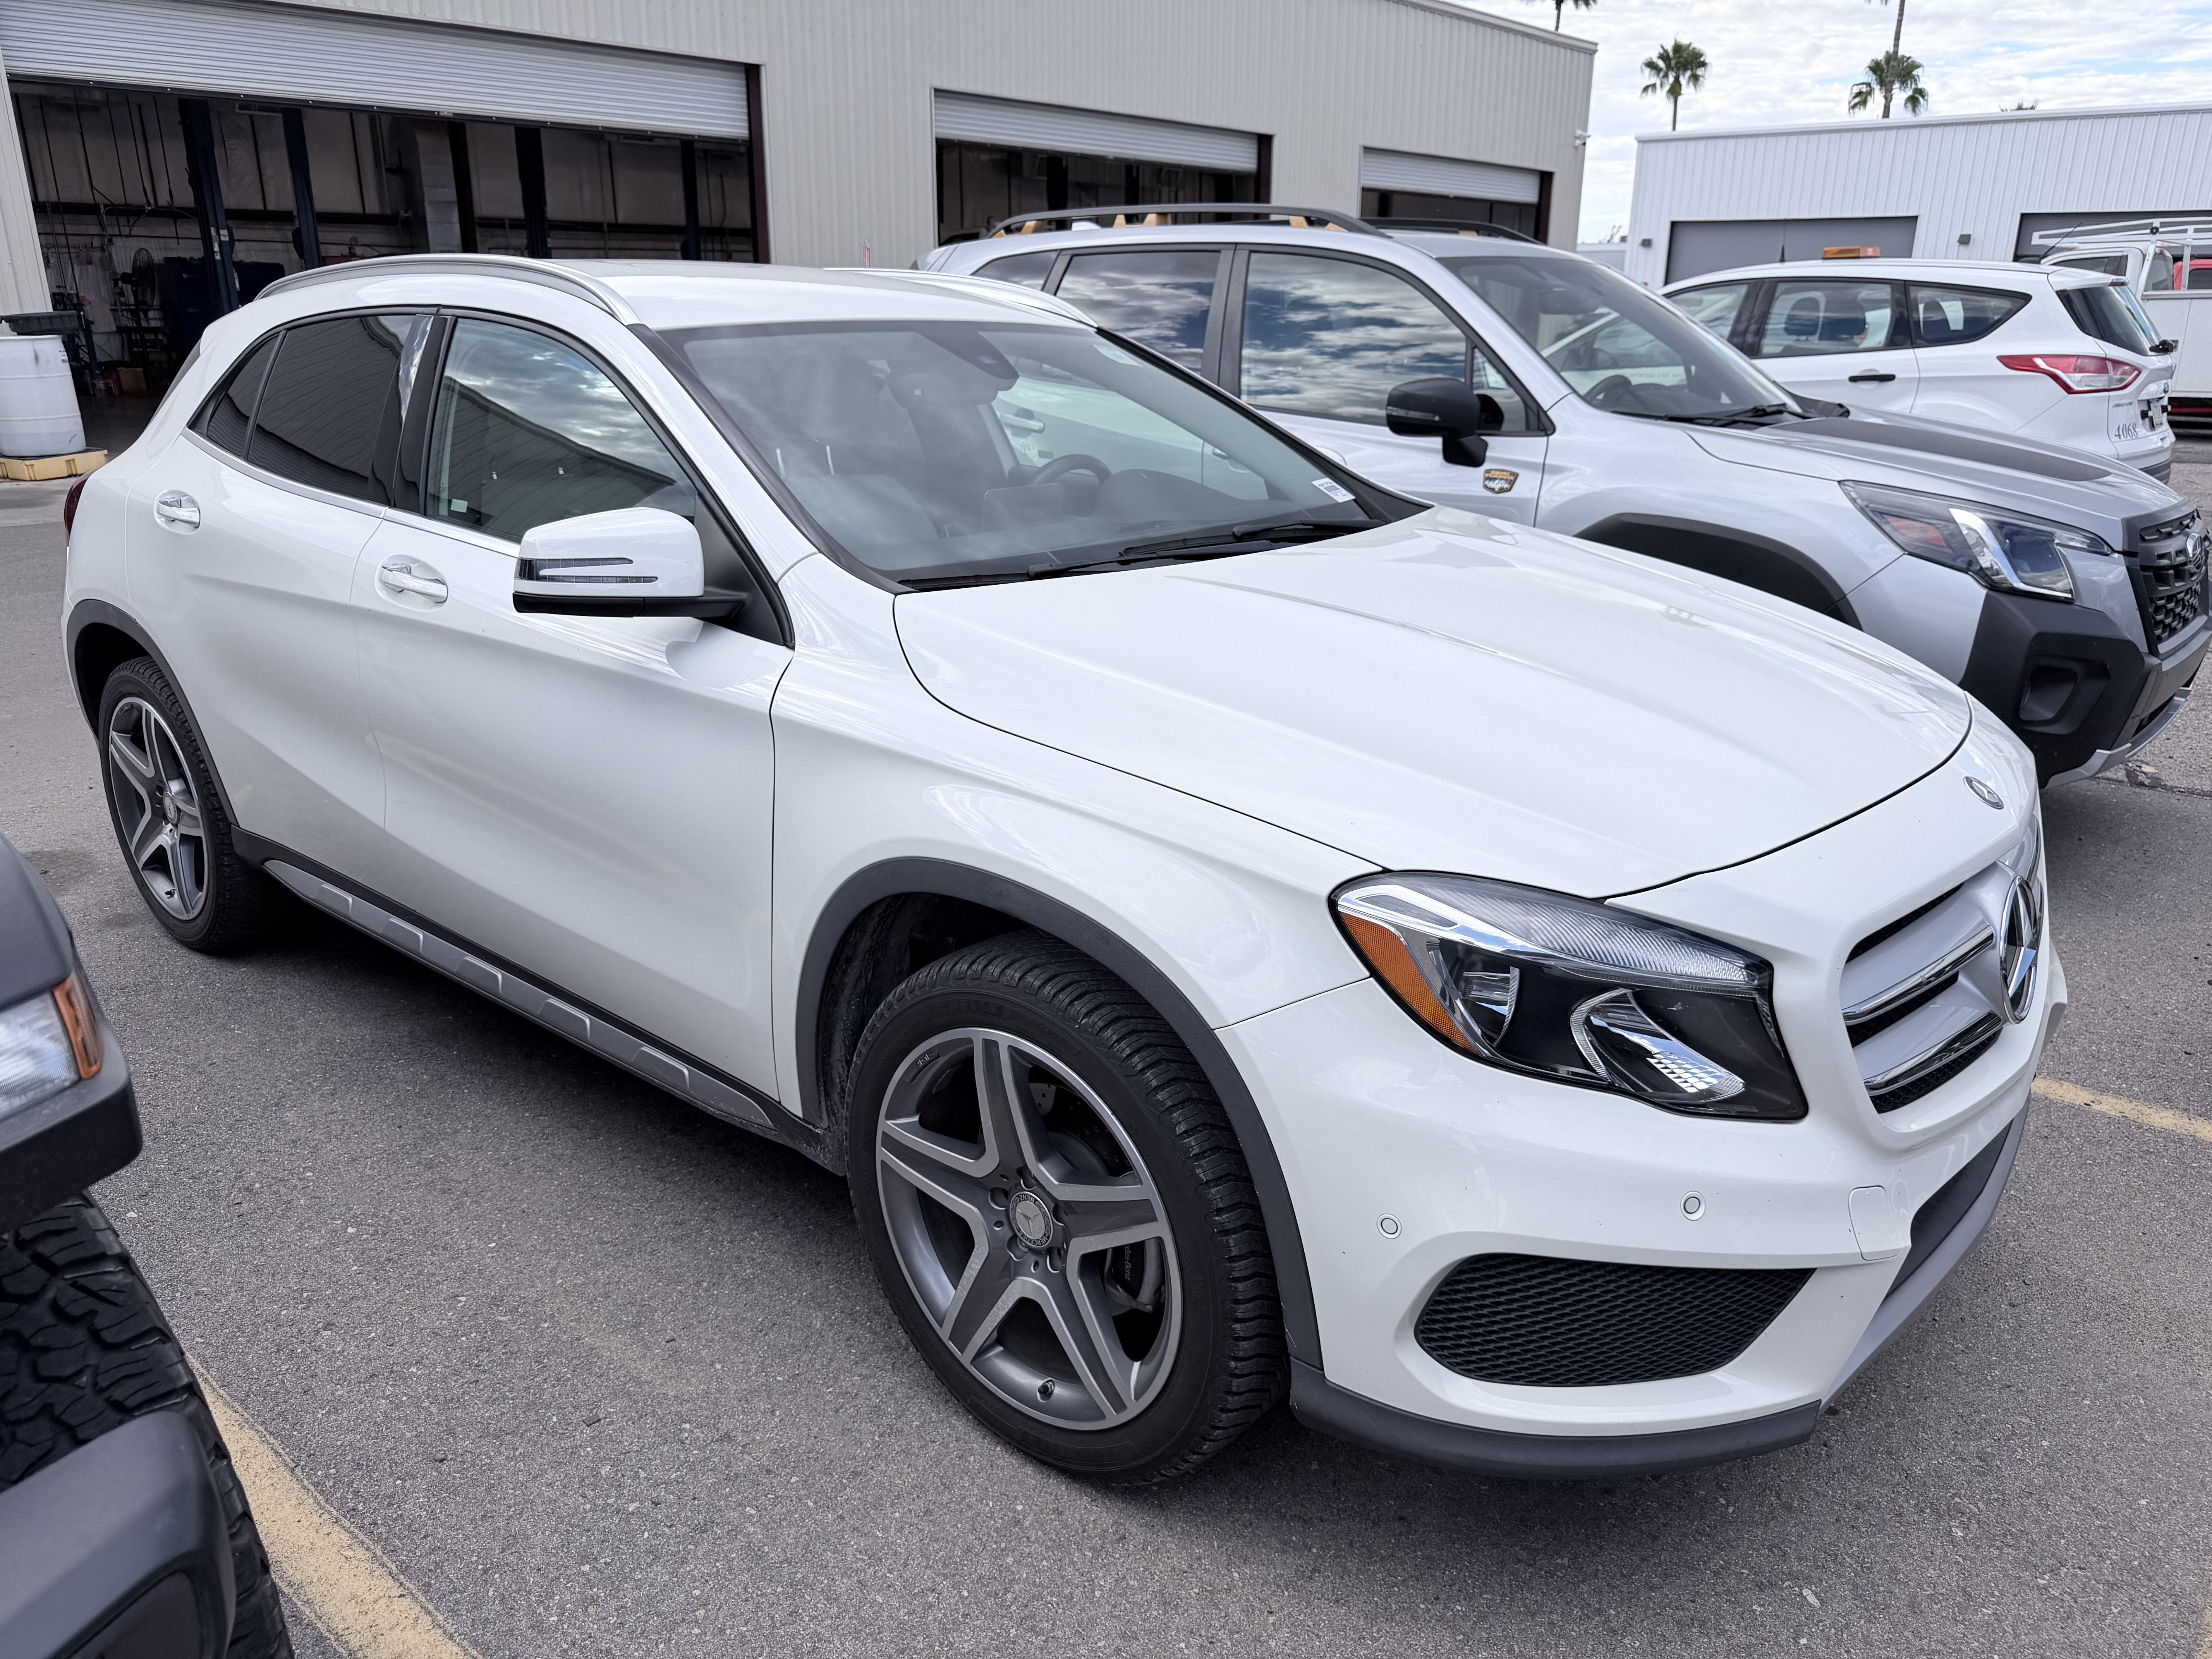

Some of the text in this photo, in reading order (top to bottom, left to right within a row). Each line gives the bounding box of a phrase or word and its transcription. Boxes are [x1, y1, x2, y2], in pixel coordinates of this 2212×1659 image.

[2114, 422, 2138, 440] 4068
[1018, 1194, 1035, 1204] BENZ
[1019, 1229, 1049, 1246] MERCEDES
